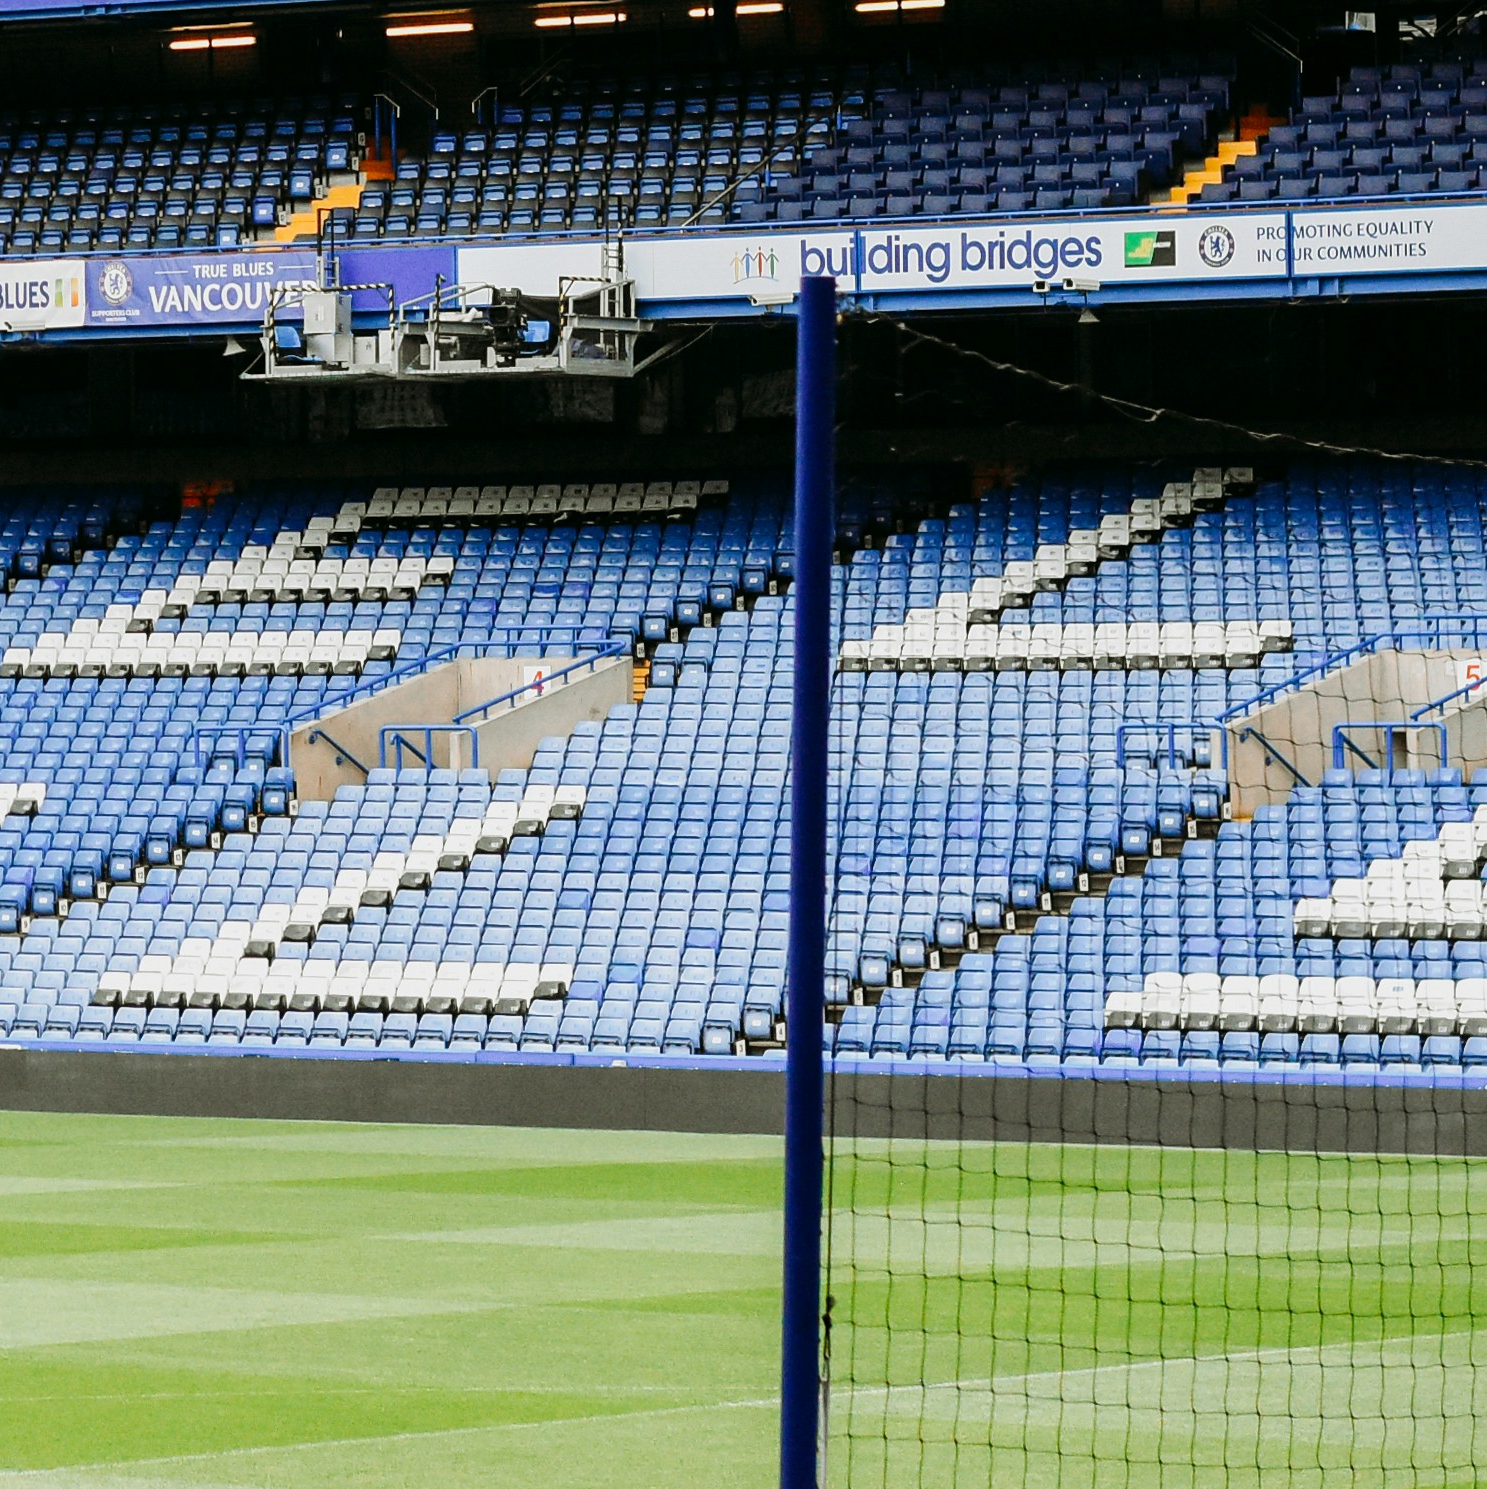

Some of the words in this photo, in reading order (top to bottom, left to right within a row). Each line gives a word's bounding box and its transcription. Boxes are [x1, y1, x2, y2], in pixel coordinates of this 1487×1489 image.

[1257, 223, 1353, 240] PROMOTING
[1357, 220, 1433, 237] EQUALITY
[801, 235, 950, 283] building
[961, 230, 1102, 279] bridges
[1257, 249, 1271, 262] IN
[1276, 246, 1312, 262] OUR
[1317, 242, 1427, 260] COMMUNITIES
[193, 264, 227, 278] TRUE
[233, 262, 274, 276] BLUES
[531, 670, 543, 693] 4
[1465, 664, 1480, 689] 5
